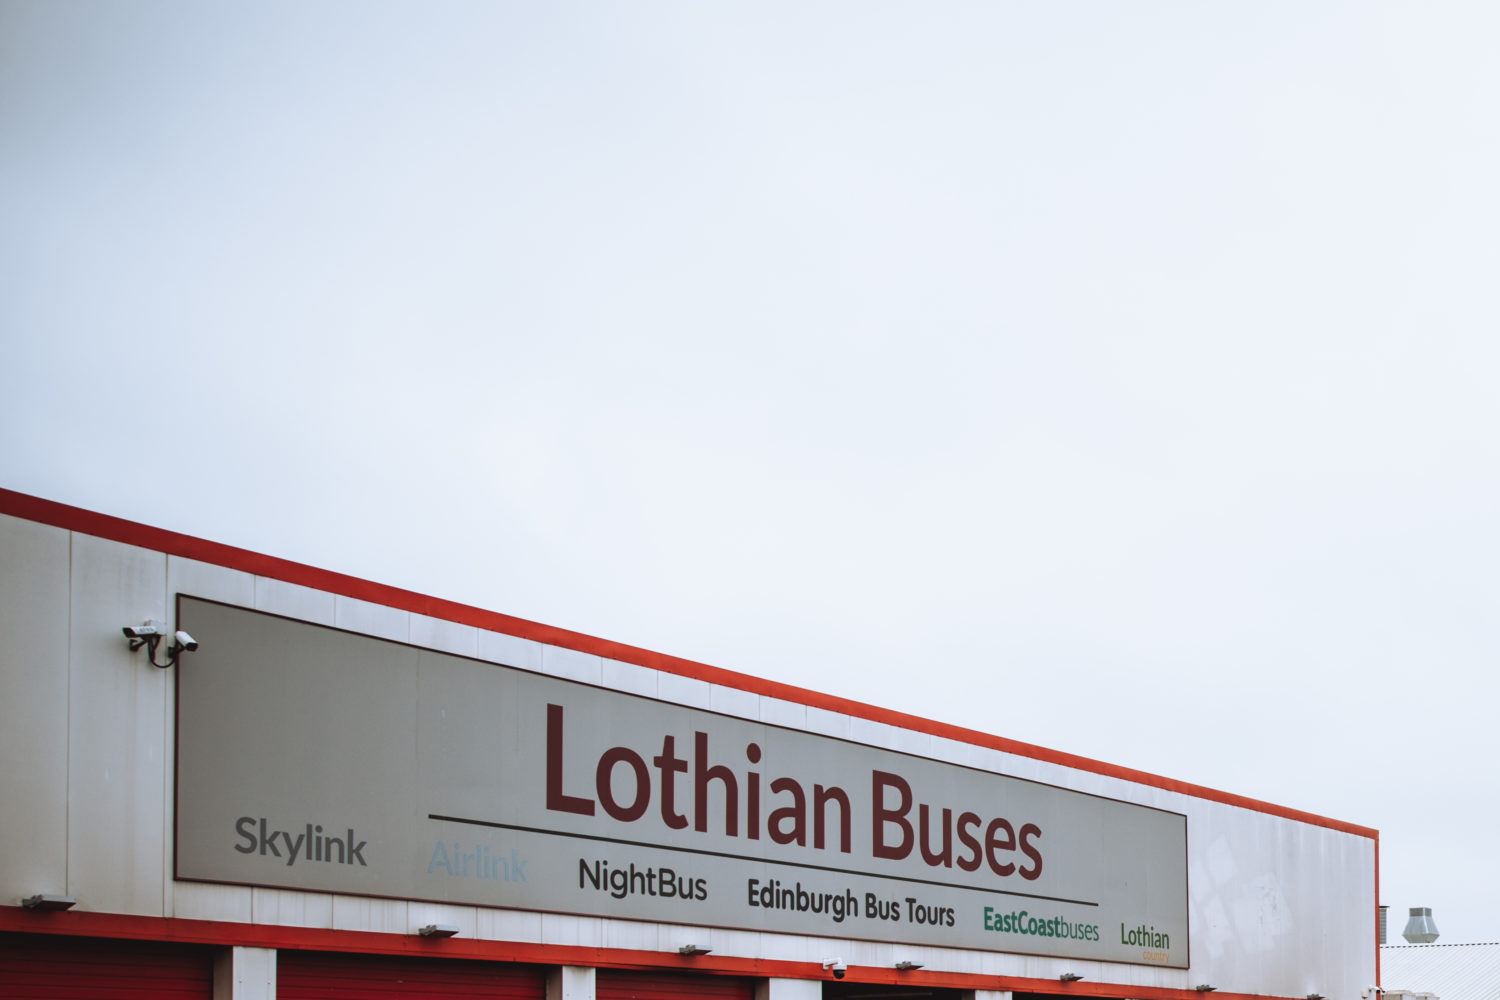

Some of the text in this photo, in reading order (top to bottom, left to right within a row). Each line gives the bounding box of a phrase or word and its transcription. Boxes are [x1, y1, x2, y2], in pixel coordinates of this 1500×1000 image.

[546, 702, 1043, 881] Lothian Buses
[234, 816, 368, 867] Skylink
[427, 840, 529, 883] Airlink
[579, 858, 708, 901] NightBus
[748, 878, 956, 927] Edinburgh Bus Tours
[983, 906, 1100, 942] EastCoastbuses
[1121, 922, 1170, 950] Lothian
[1142, 950, 1170, 965] country
